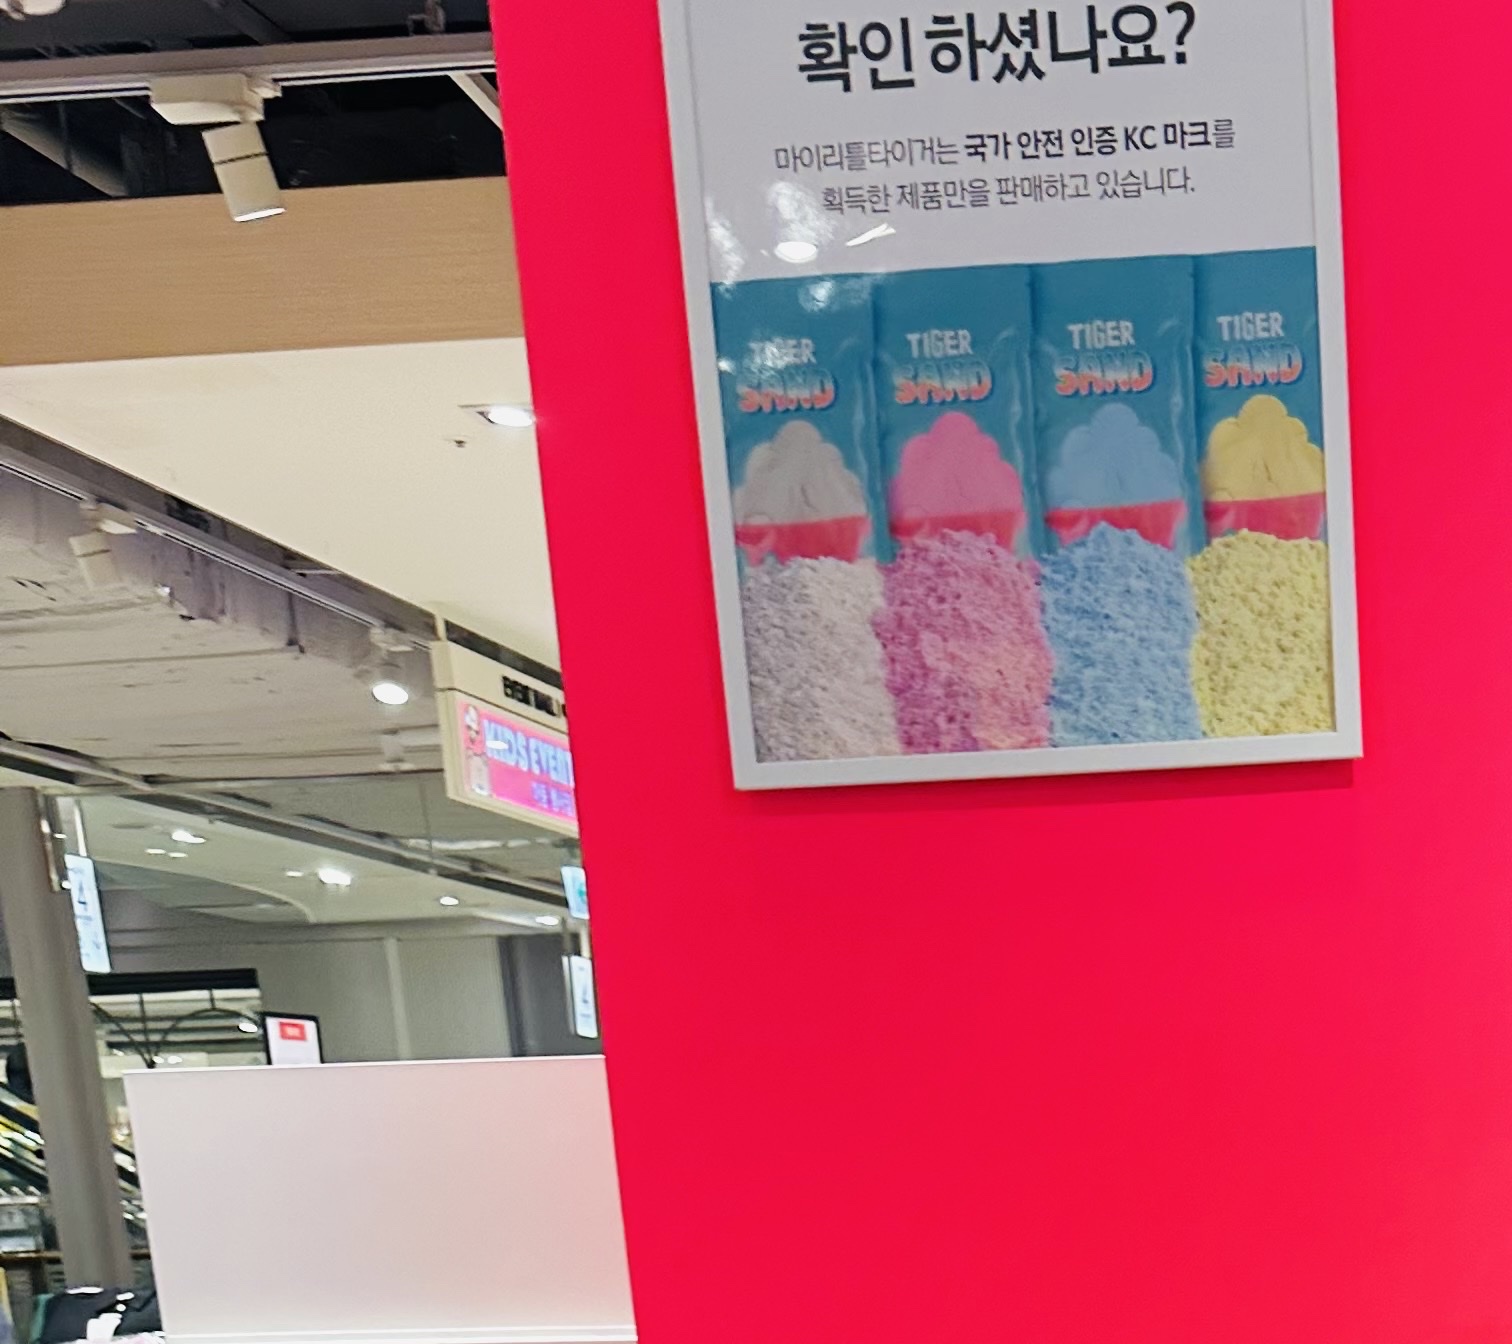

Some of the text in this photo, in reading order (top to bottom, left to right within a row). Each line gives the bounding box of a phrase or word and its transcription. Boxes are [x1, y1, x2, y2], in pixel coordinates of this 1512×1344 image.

[798, 1, 1196, 92] 확인 하셨나요?
[964, 132, 1010, 163] 국가
[1017, 128, 1064, 159] 안전
[1071, 125, 1117, 156] 인증
[1124, 125, 1158, 151] KC
[1163, 118, 1236, 151] 마크를
[822, 166, 1196, 214] 획득한 제품만을 판매하고 있습니다.
[906, 329, 972, 359] TIGER
[1068, 320, 1135, 349] TIGER
[1217, 312, 1284, 341] TIGER
[893, 359, 992, 404] SAND
[1055, 350, 1153, 396] SAND
[1203, 342, 1302, 388] SAND
